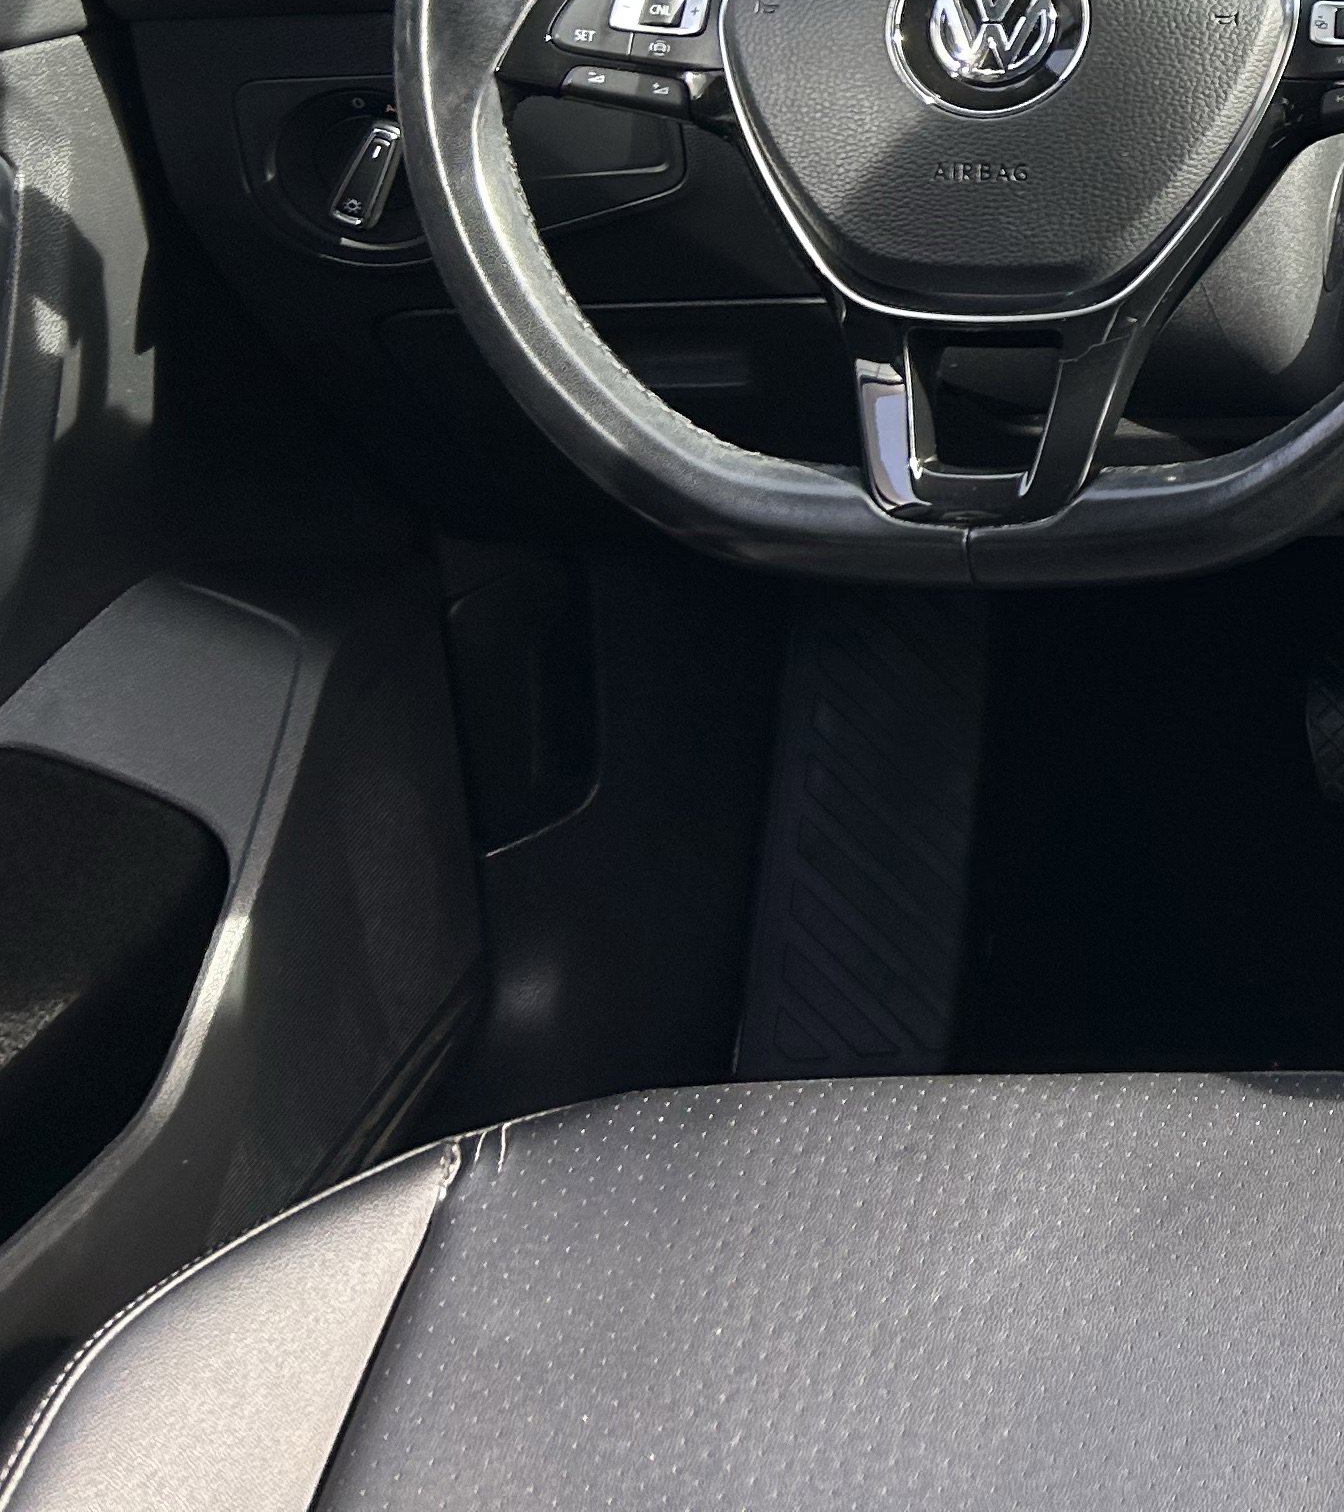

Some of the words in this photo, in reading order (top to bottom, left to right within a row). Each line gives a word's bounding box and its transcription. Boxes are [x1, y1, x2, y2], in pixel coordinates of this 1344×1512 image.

[650, 4, 670, 16] CNL
[574, 28, 596, 42] SET
[932, 162, 1029, 182] AIRBAG
